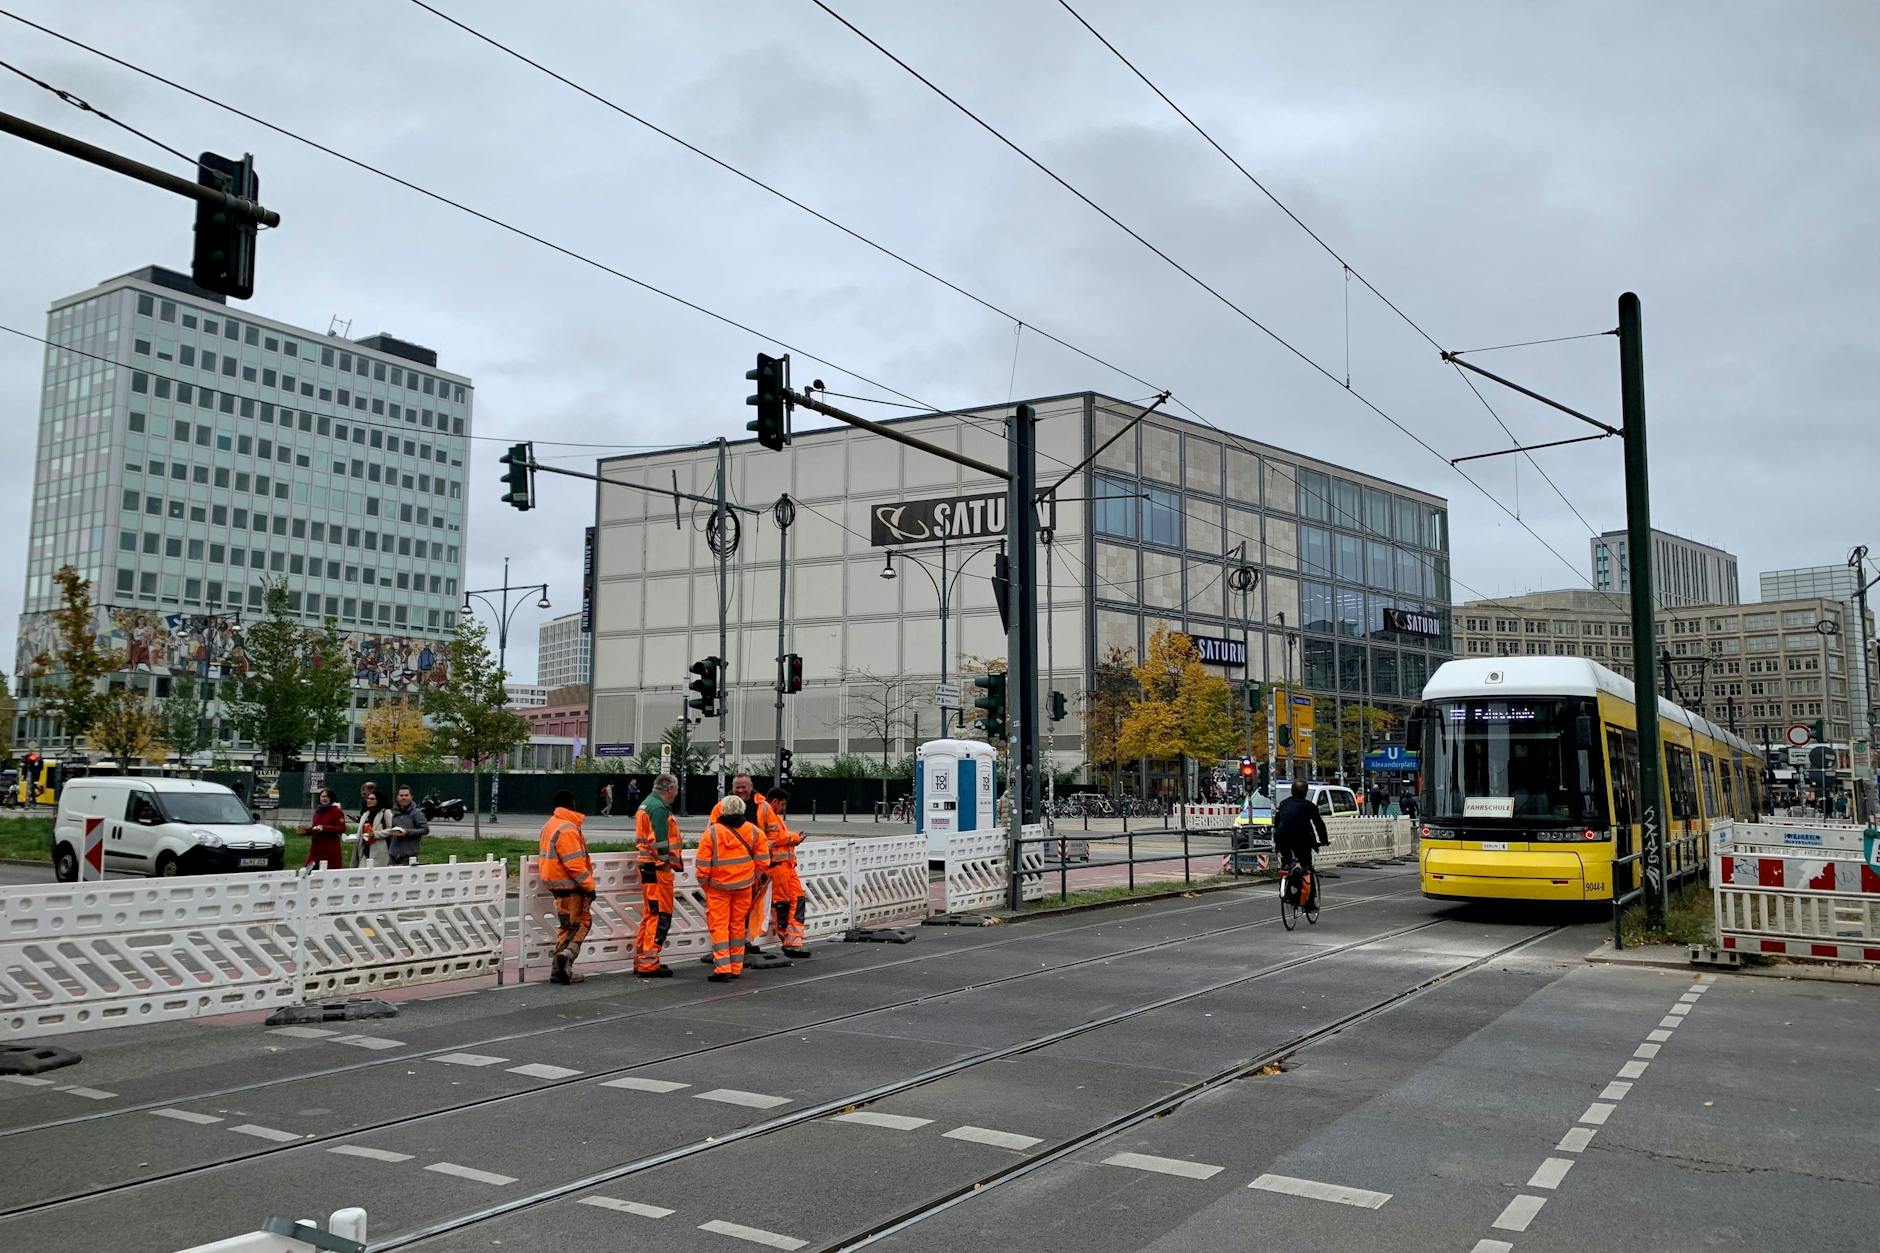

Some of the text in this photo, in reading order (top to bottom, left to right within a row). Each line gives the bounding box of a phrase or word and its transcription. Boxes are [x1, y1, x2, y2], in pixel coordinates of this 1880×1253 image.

[933, 494, 1050, 538] SATUN
[1406, 613, 1440, 636] SATURN
[1199, 638, 1245, 663] SATURN
[1387, 747, 1398, 760] U
